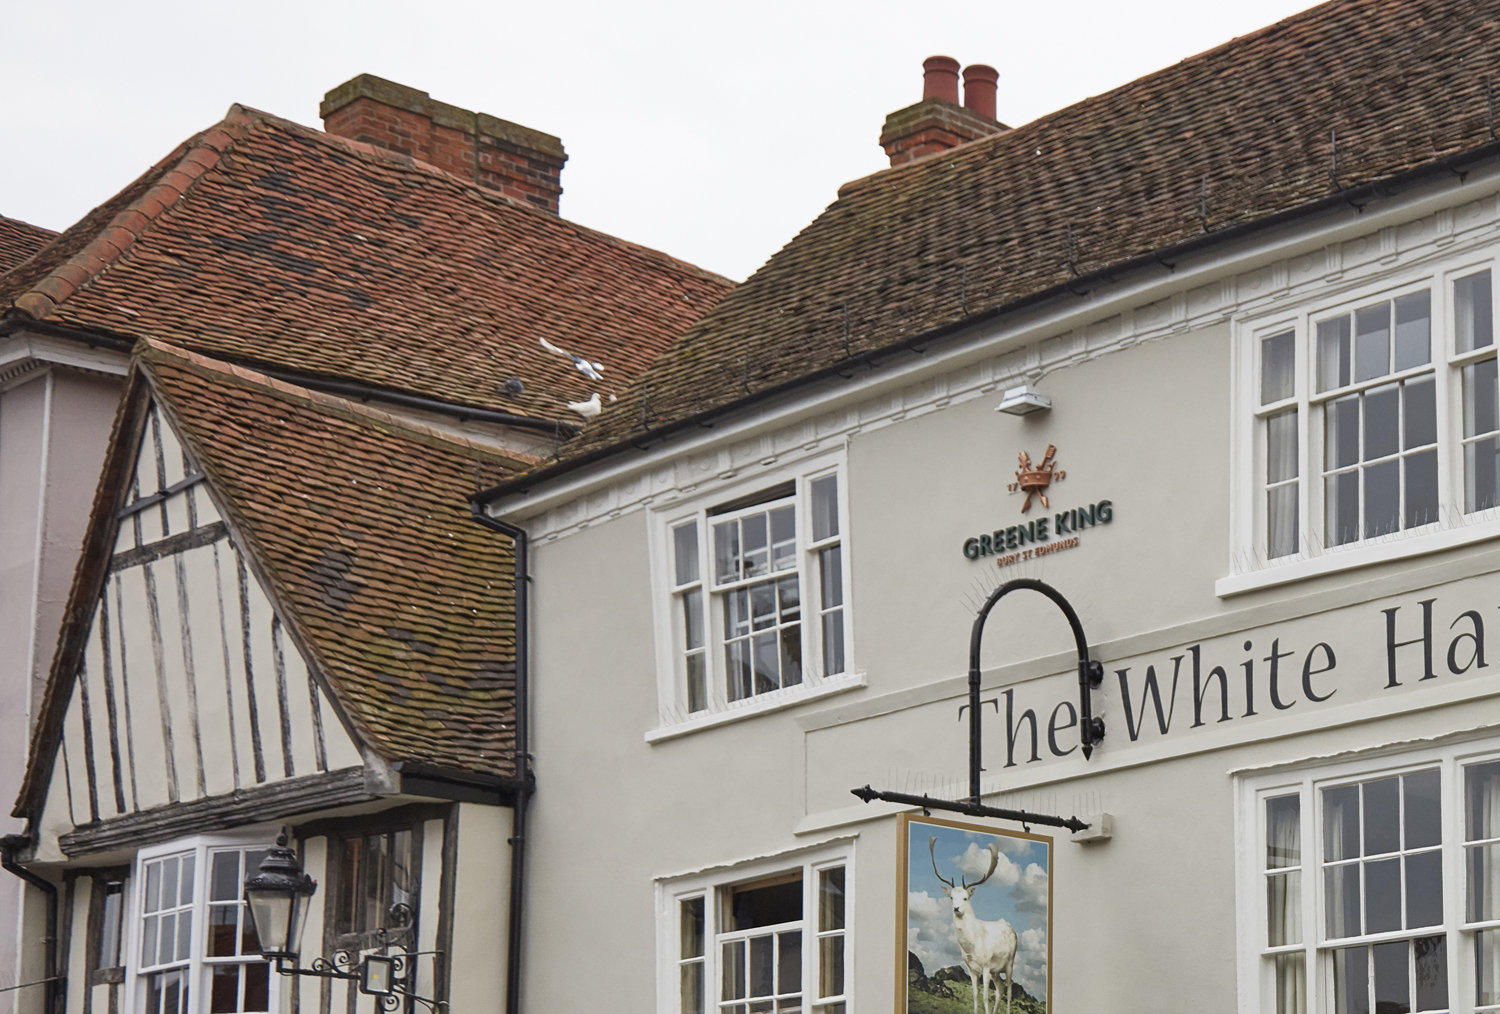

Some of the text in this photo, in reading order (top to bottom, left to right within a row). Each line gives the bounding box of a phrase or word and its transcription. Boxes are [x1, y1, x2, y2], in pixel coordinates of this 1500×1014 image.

[962, 500, 1113, 561] GREENE KING
[997, 552, 1020, 568] BURY
[1034, 537, 1079, 557] EDMUNDS
[1113, 637, 1338, 743] White
